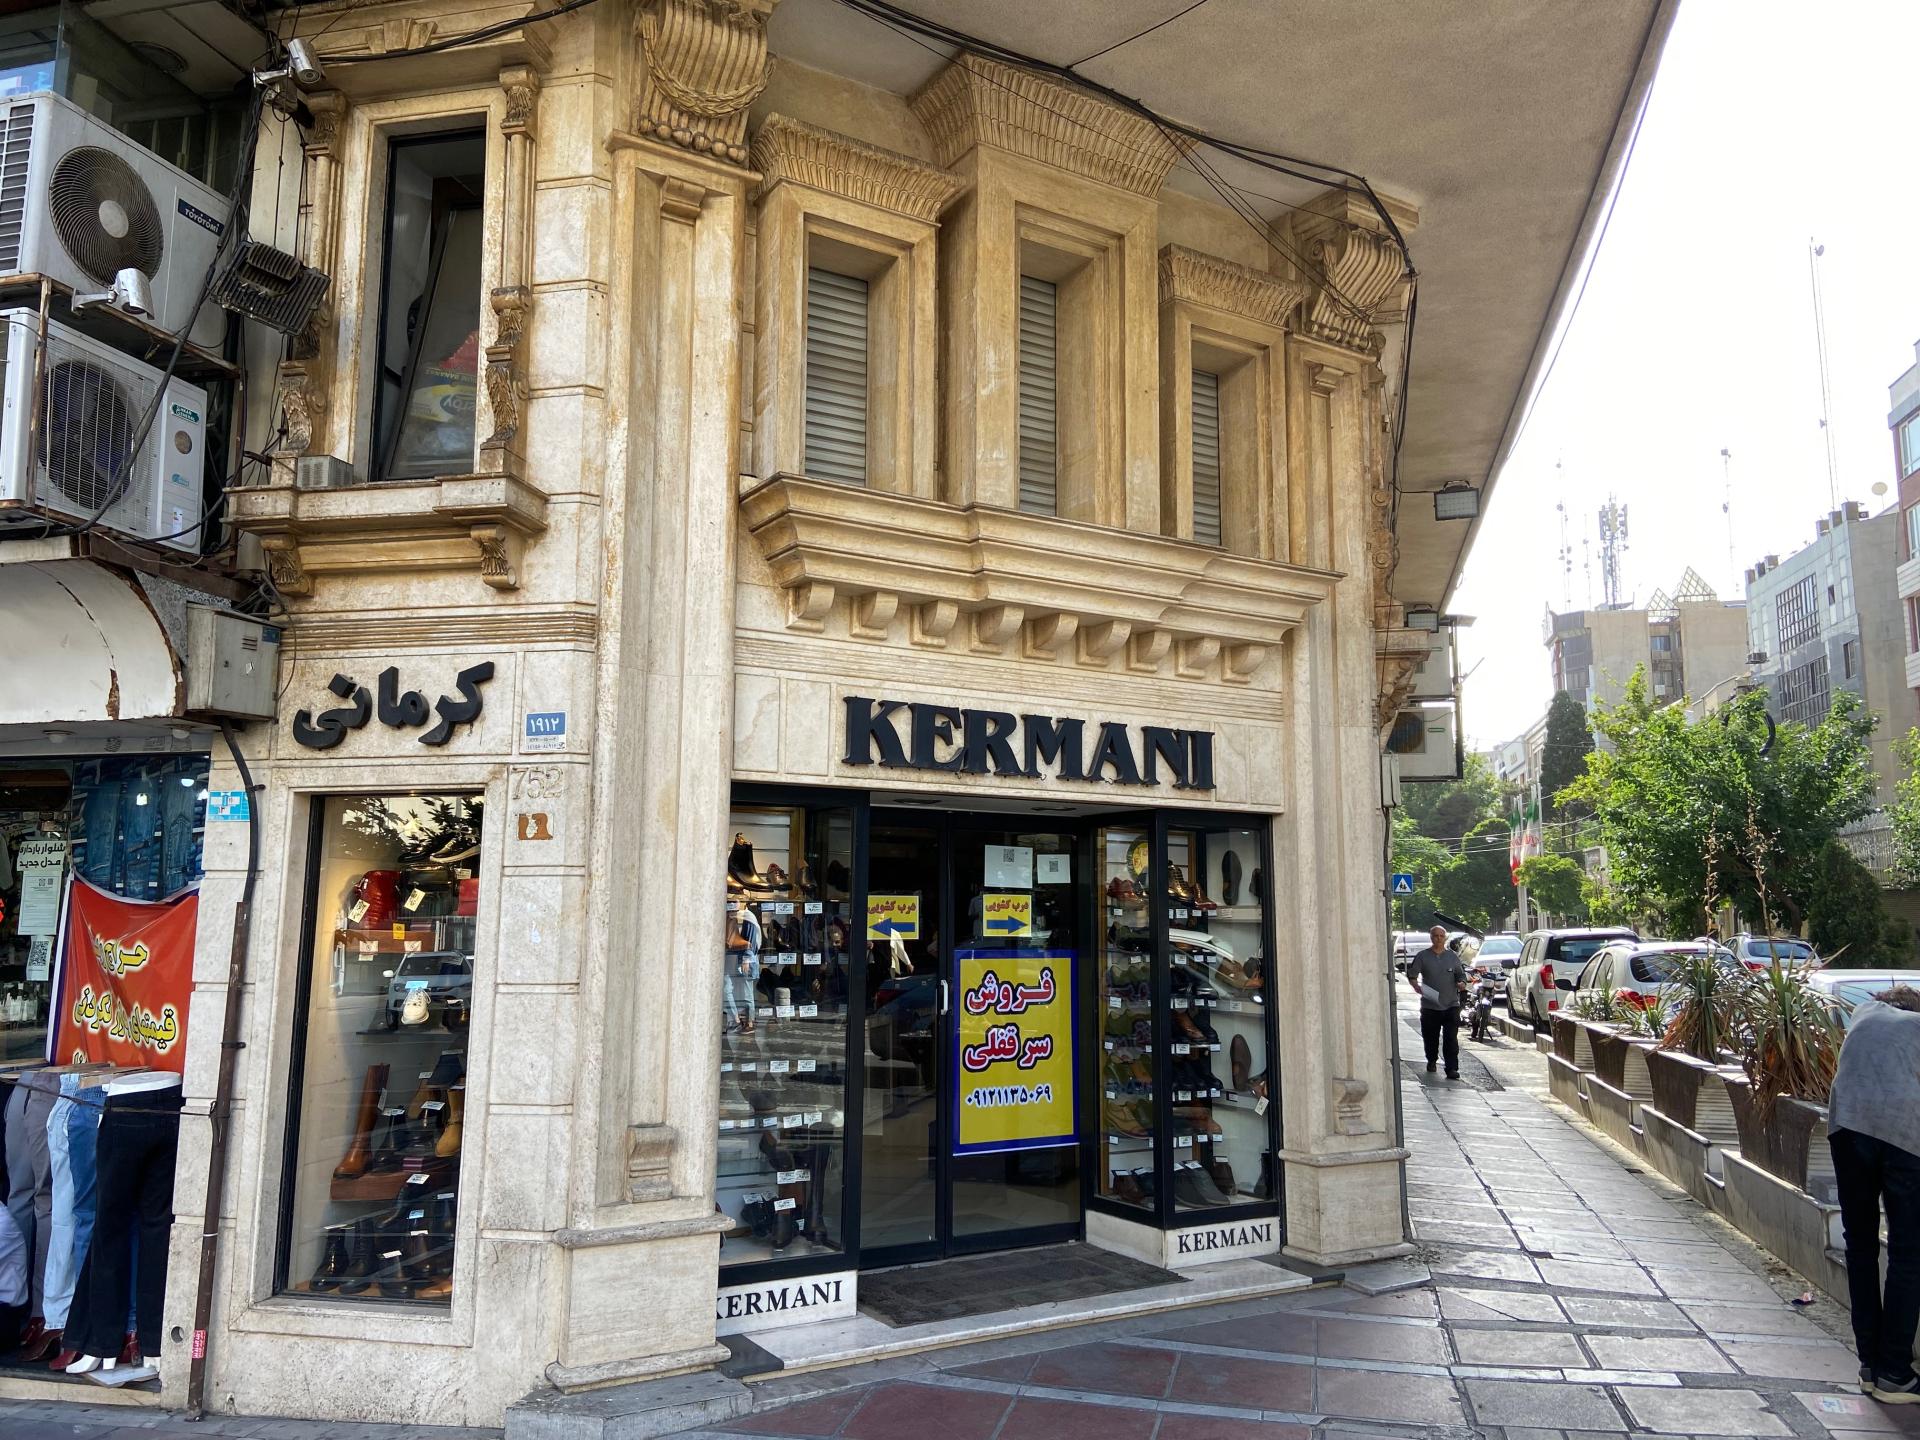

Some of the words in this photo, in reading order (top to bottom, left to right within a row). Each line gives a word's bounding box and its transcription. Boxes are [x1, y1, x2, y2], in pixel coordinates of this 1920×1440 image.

[292, 661, 495, 749] کرمانی
[530, 717, 560, 733] ۱۹۱۲
[841, 696, 1216, 790] KERMANI
[511, 766, 563, 800] 752
[19, 860, 39, 868] جدید
[40, 856, 61, 868] مدل
[41, 842, 66, 855] شلوار
[964, 967, 1056, 1015] فروش
[962, 1022, 1020, 1073] قفلی
[1016, 1033, 1054, 1071] سر
[966, 1083, 1053, 1108] ۰۹۱۲۱۱۳۵۰۶۹
[1177, 1223, 1272, 1254] KERMANI
